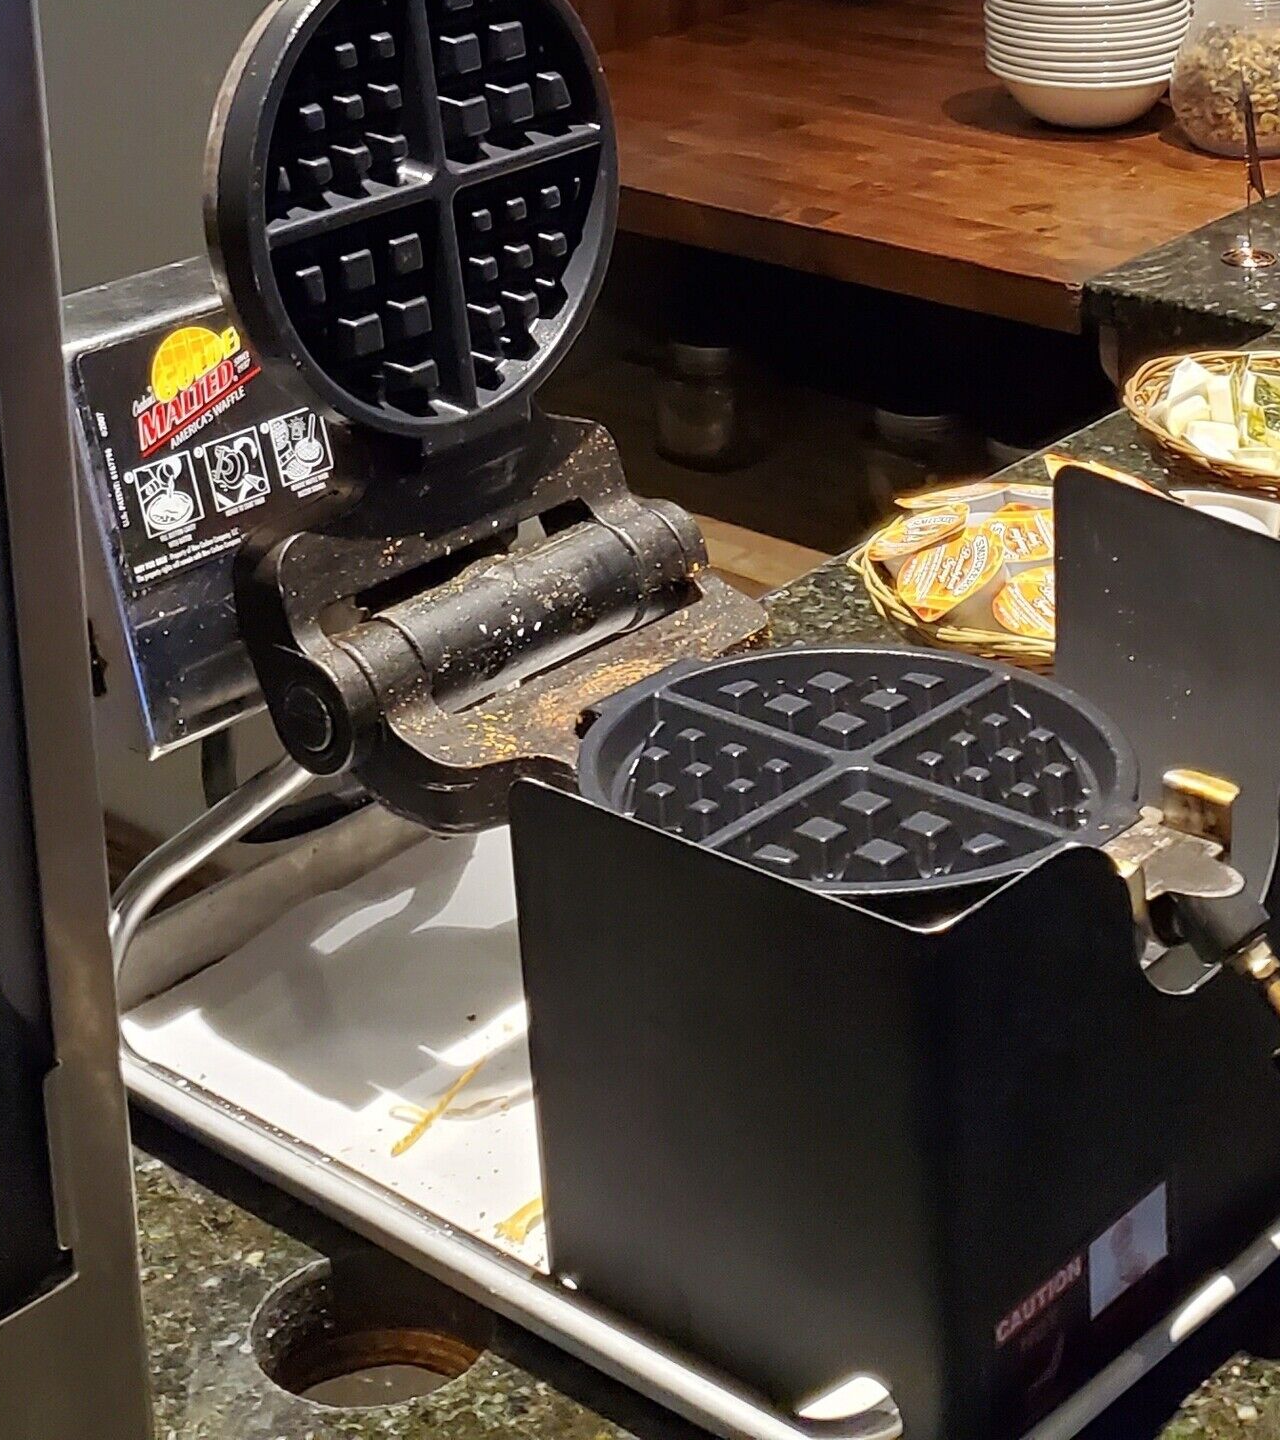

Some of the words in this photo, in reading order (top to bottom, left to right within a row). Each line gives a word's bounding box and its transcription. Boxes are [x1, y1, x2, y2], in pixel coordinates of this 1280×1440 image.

[137, 359, 235, 452] MALTED
[214, 385, 246, 417] WAFFLE
[112, 479, 127, 512] PATENT
